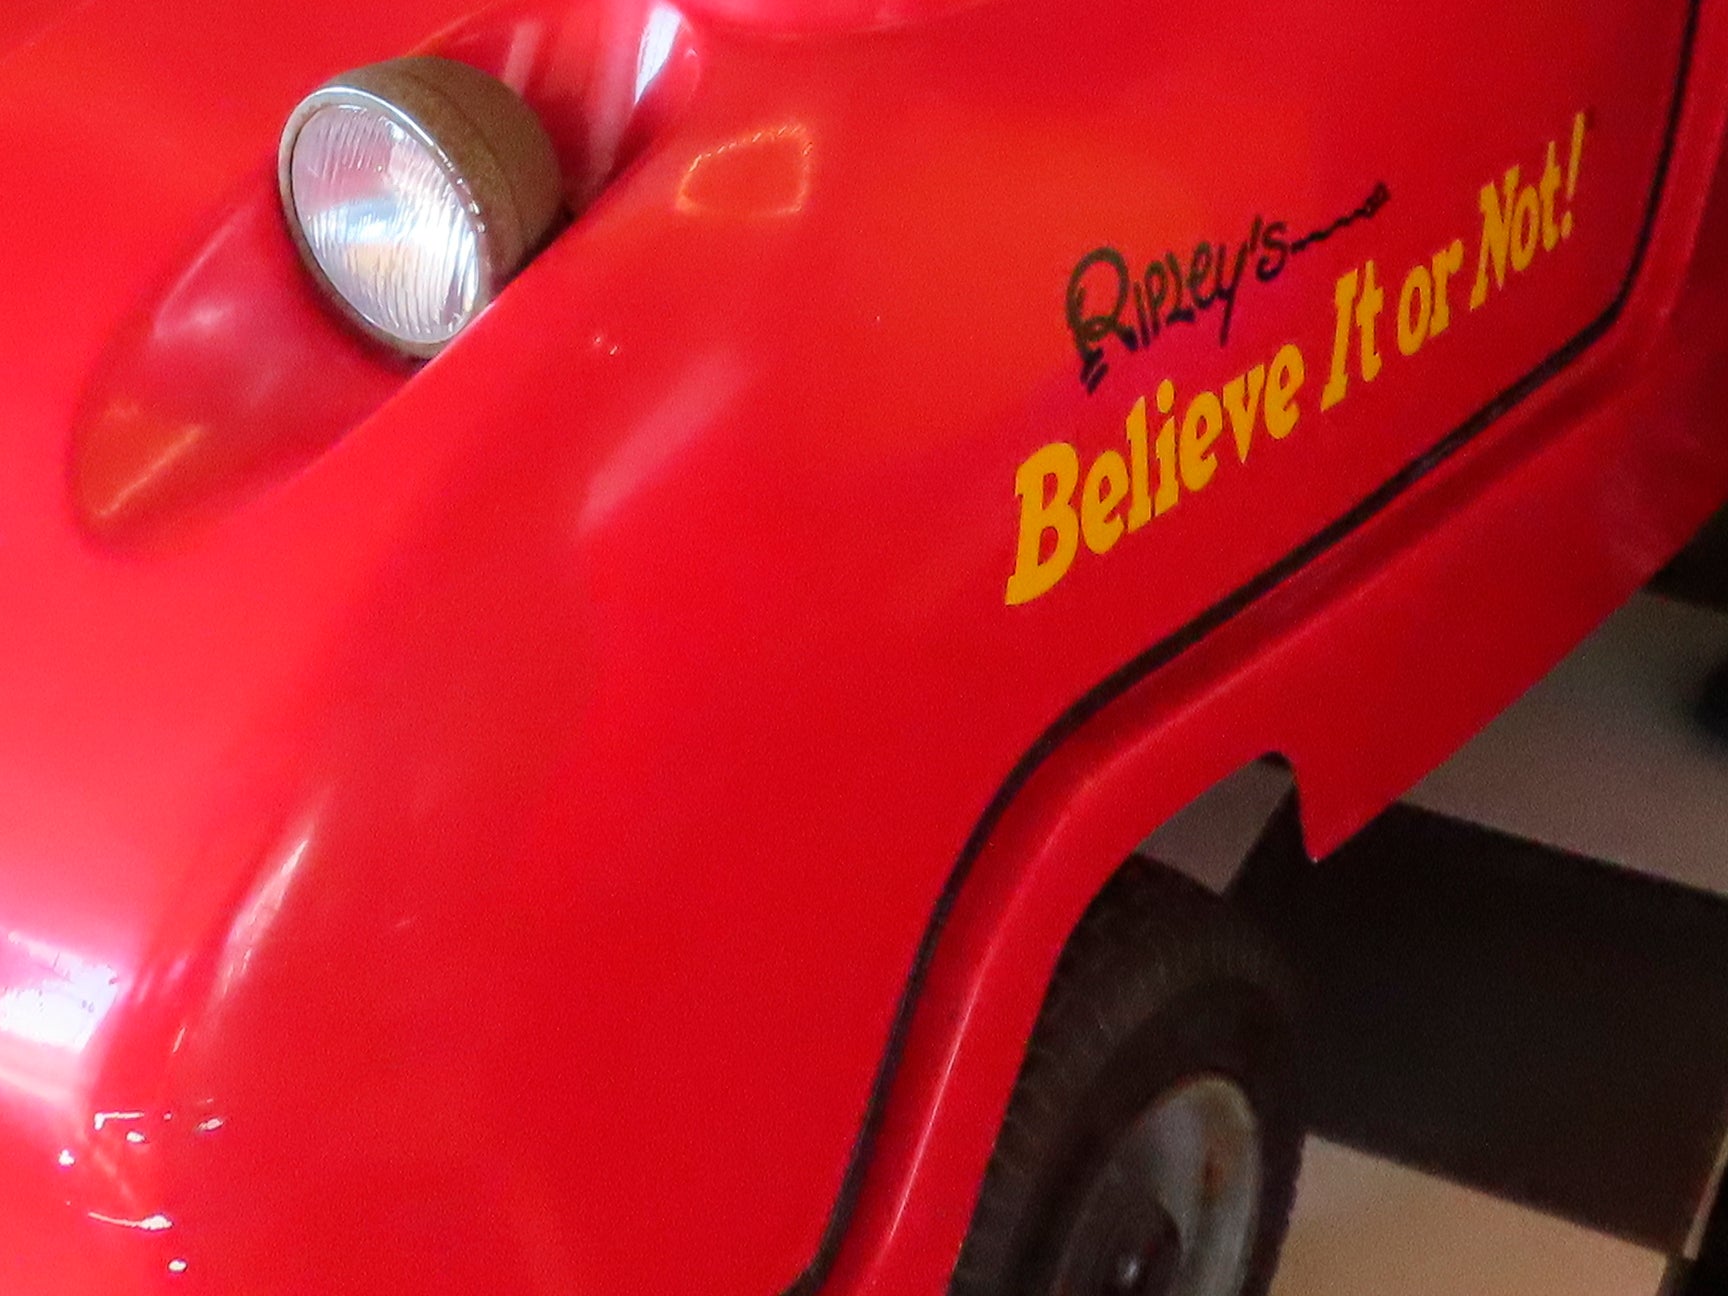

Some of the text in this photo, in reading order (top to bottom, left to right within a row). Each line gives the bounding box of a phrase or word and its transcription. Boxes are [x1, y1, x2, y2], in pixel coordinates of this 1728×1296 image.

[1005, 111, 1586, 606] Believe It or Not!
